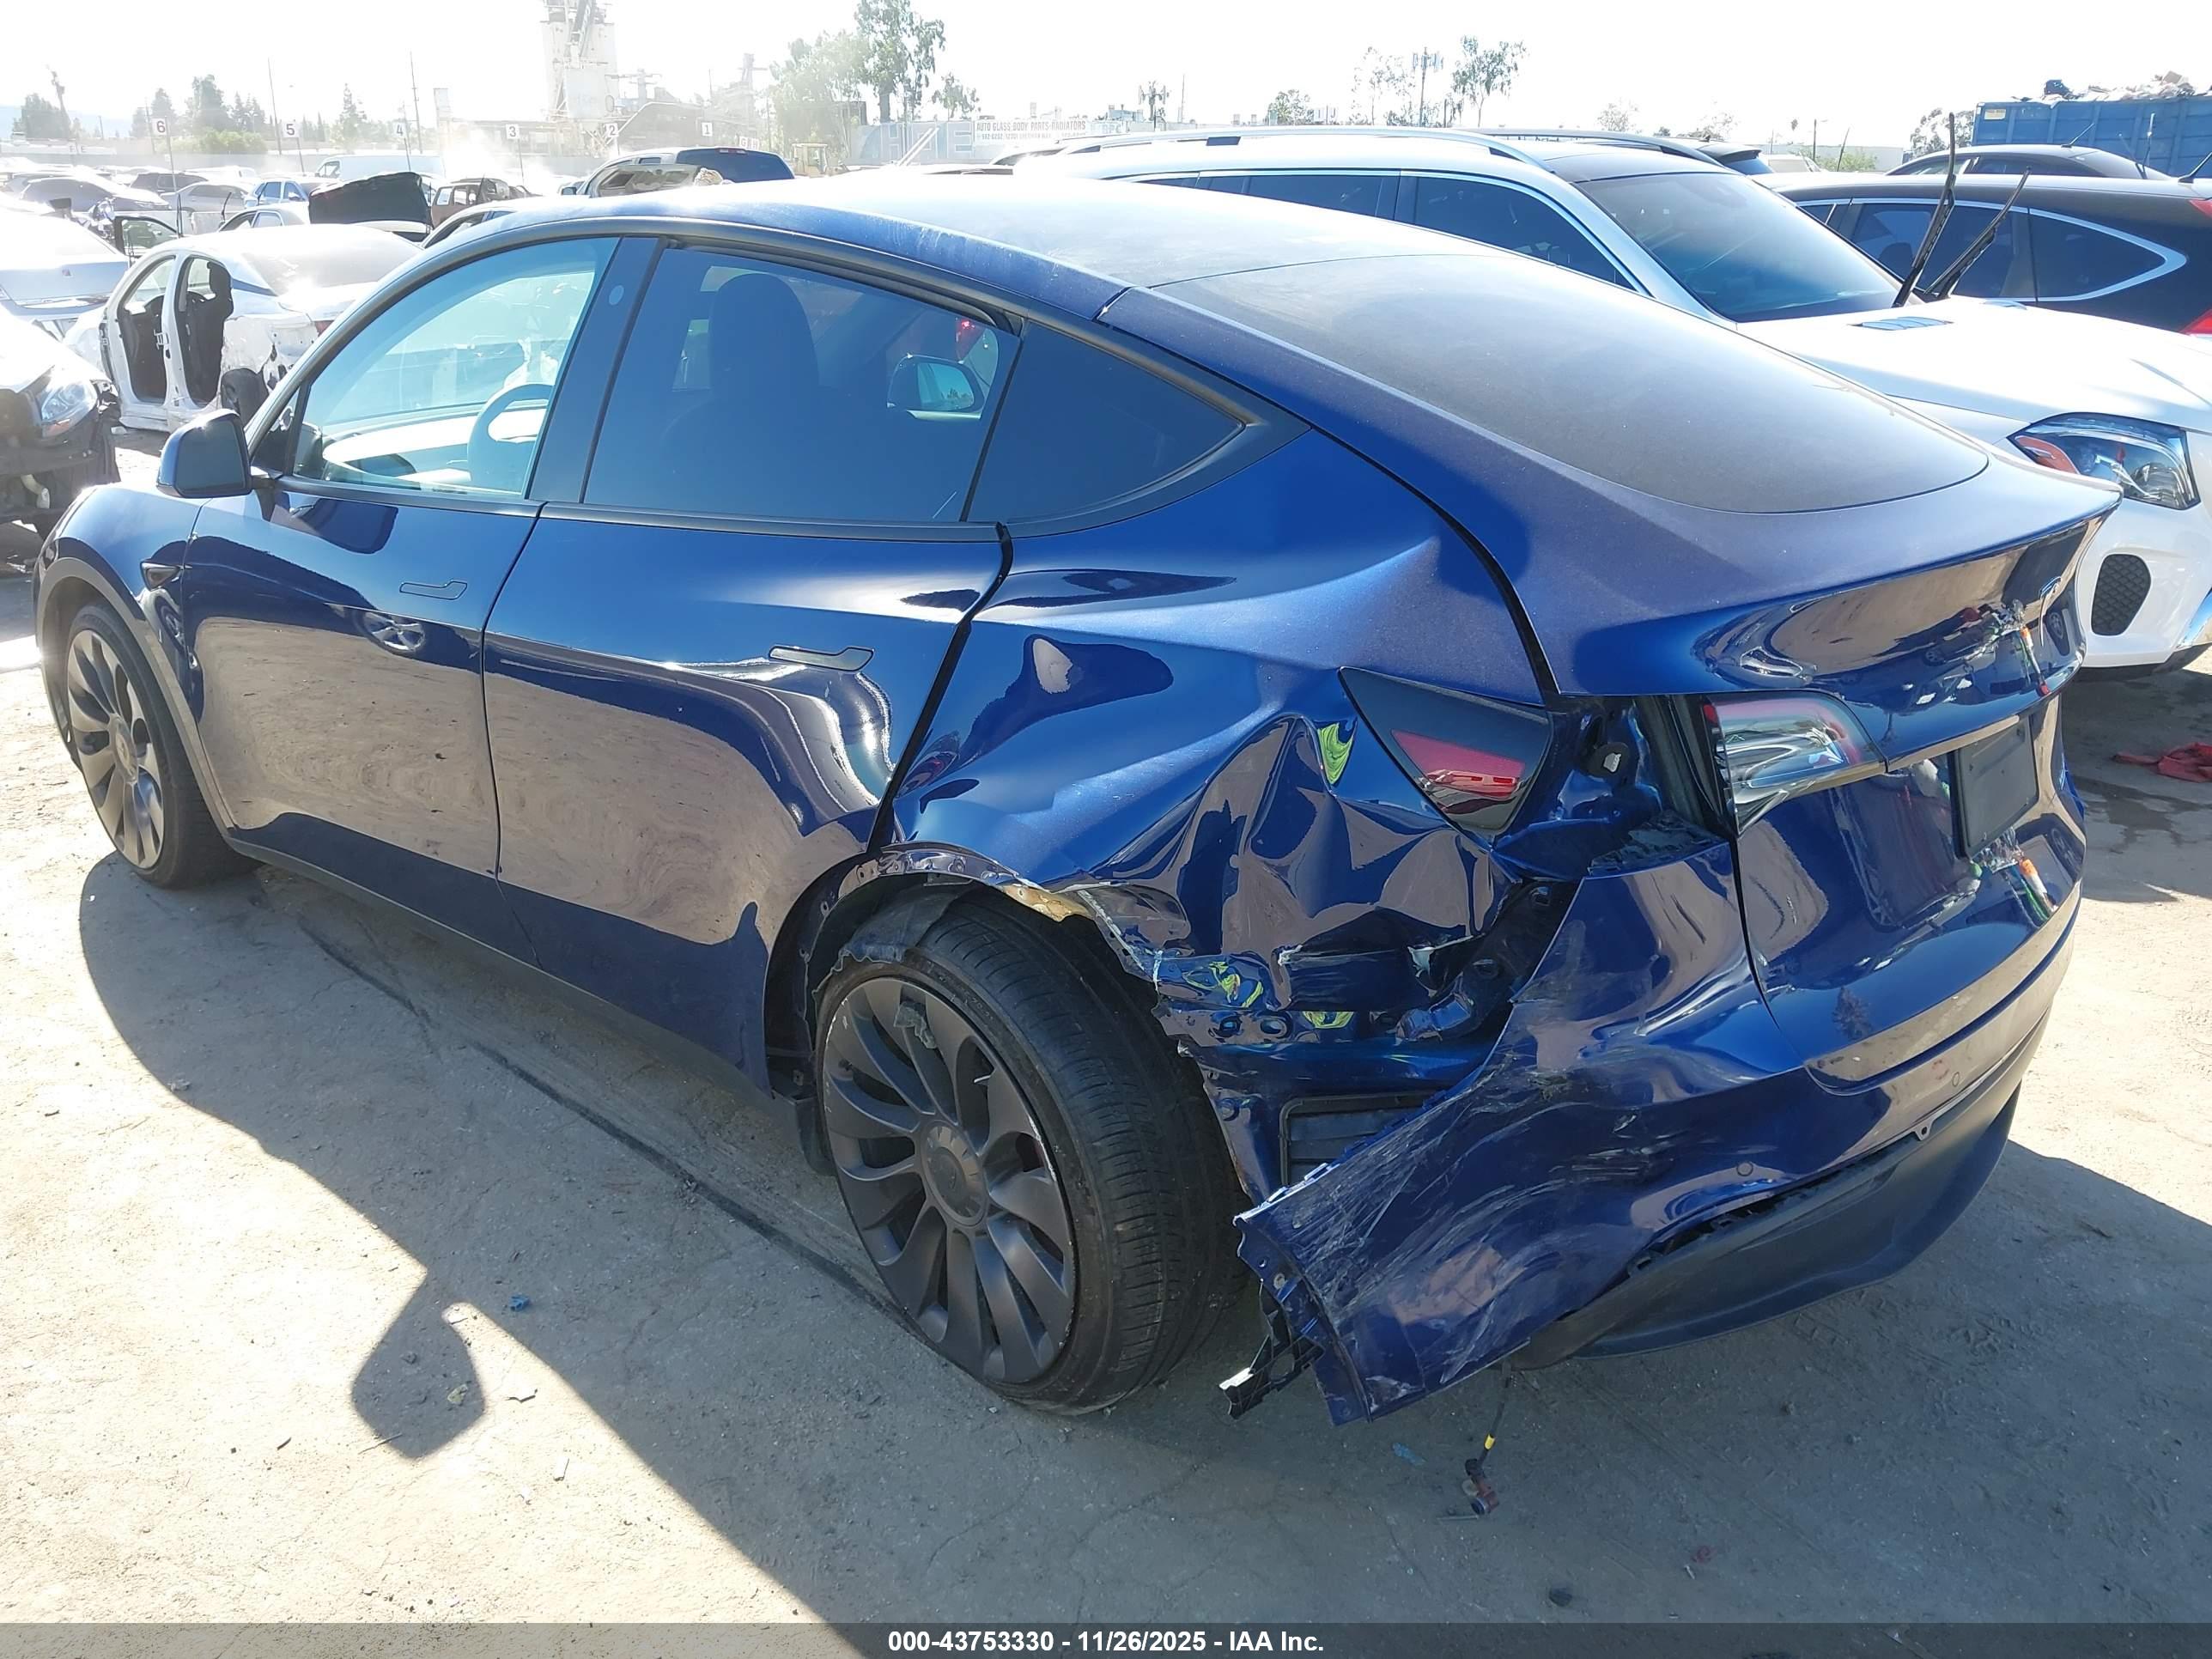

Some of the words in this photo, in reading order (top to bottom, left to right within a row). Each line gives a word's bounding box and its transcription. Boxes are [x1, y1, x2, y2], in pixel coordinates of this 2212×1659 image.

[156, 120, 166, 133] 6
[286, 123, 295, 136] 5
[396, 125, 404, 137] 4
[508, 125, 517, 137] 3
[610, 125, 617, 136] 2
[704, 124, 712, 135] 1
[976, 122, 991, 131] AUTO
[993, 122, 1011, 131] GLASS
[1012, 121, 1029, 131] BODY
